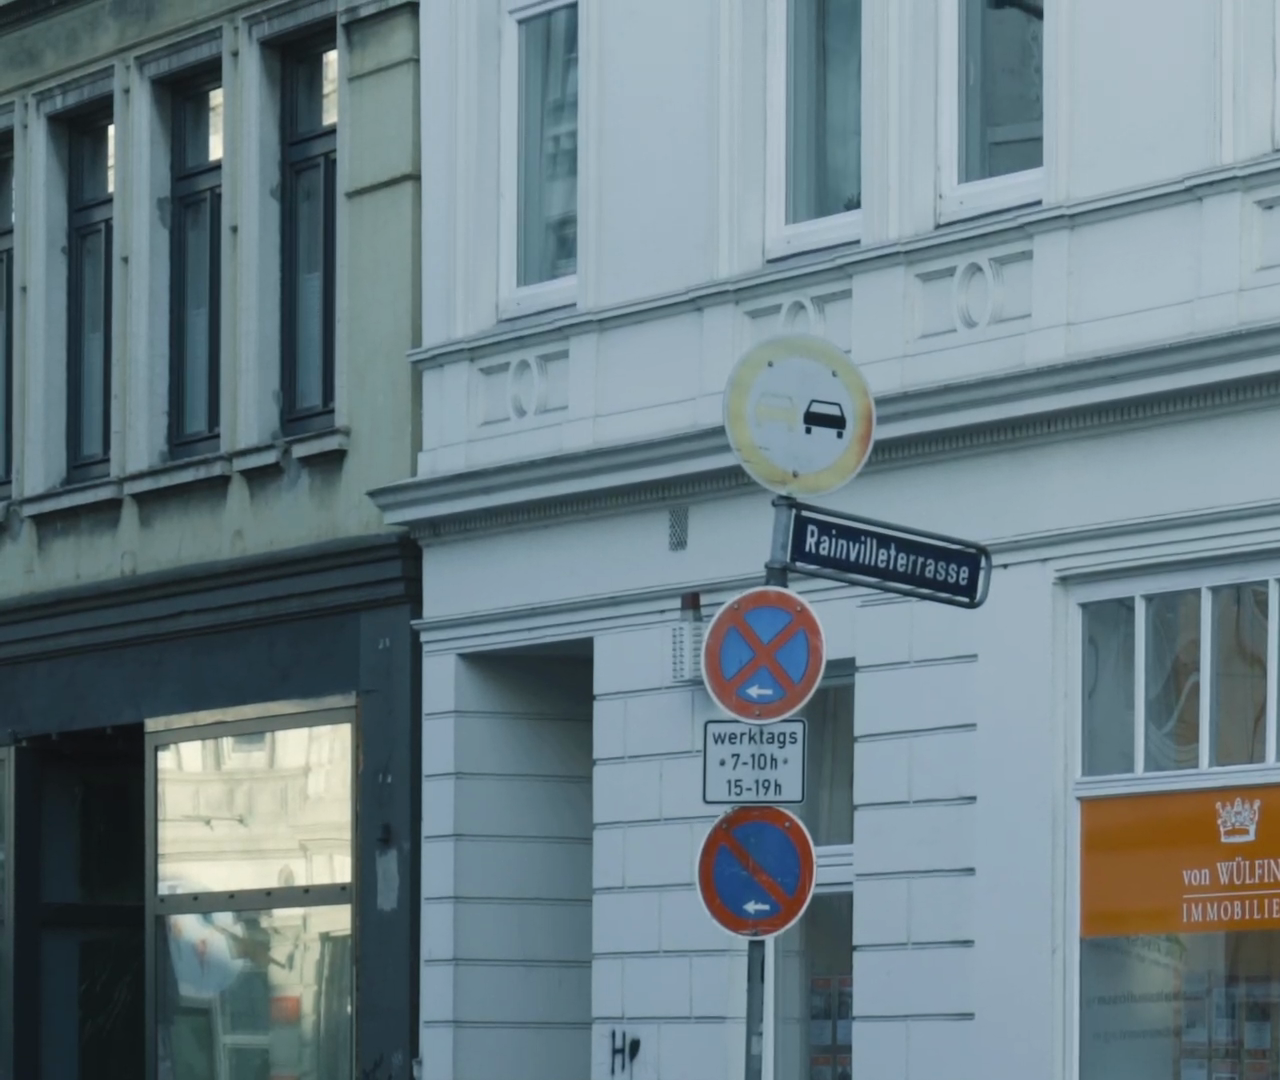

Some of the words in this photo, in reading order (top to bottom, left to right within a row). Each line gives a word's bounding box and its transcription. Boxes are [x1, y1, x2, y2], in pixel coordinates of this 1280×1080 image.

[805, 524, 970, 586] Rainvilleterrasse
[712, 727, 798, 749] werktags
[1182, 868, 1210, 886] von
